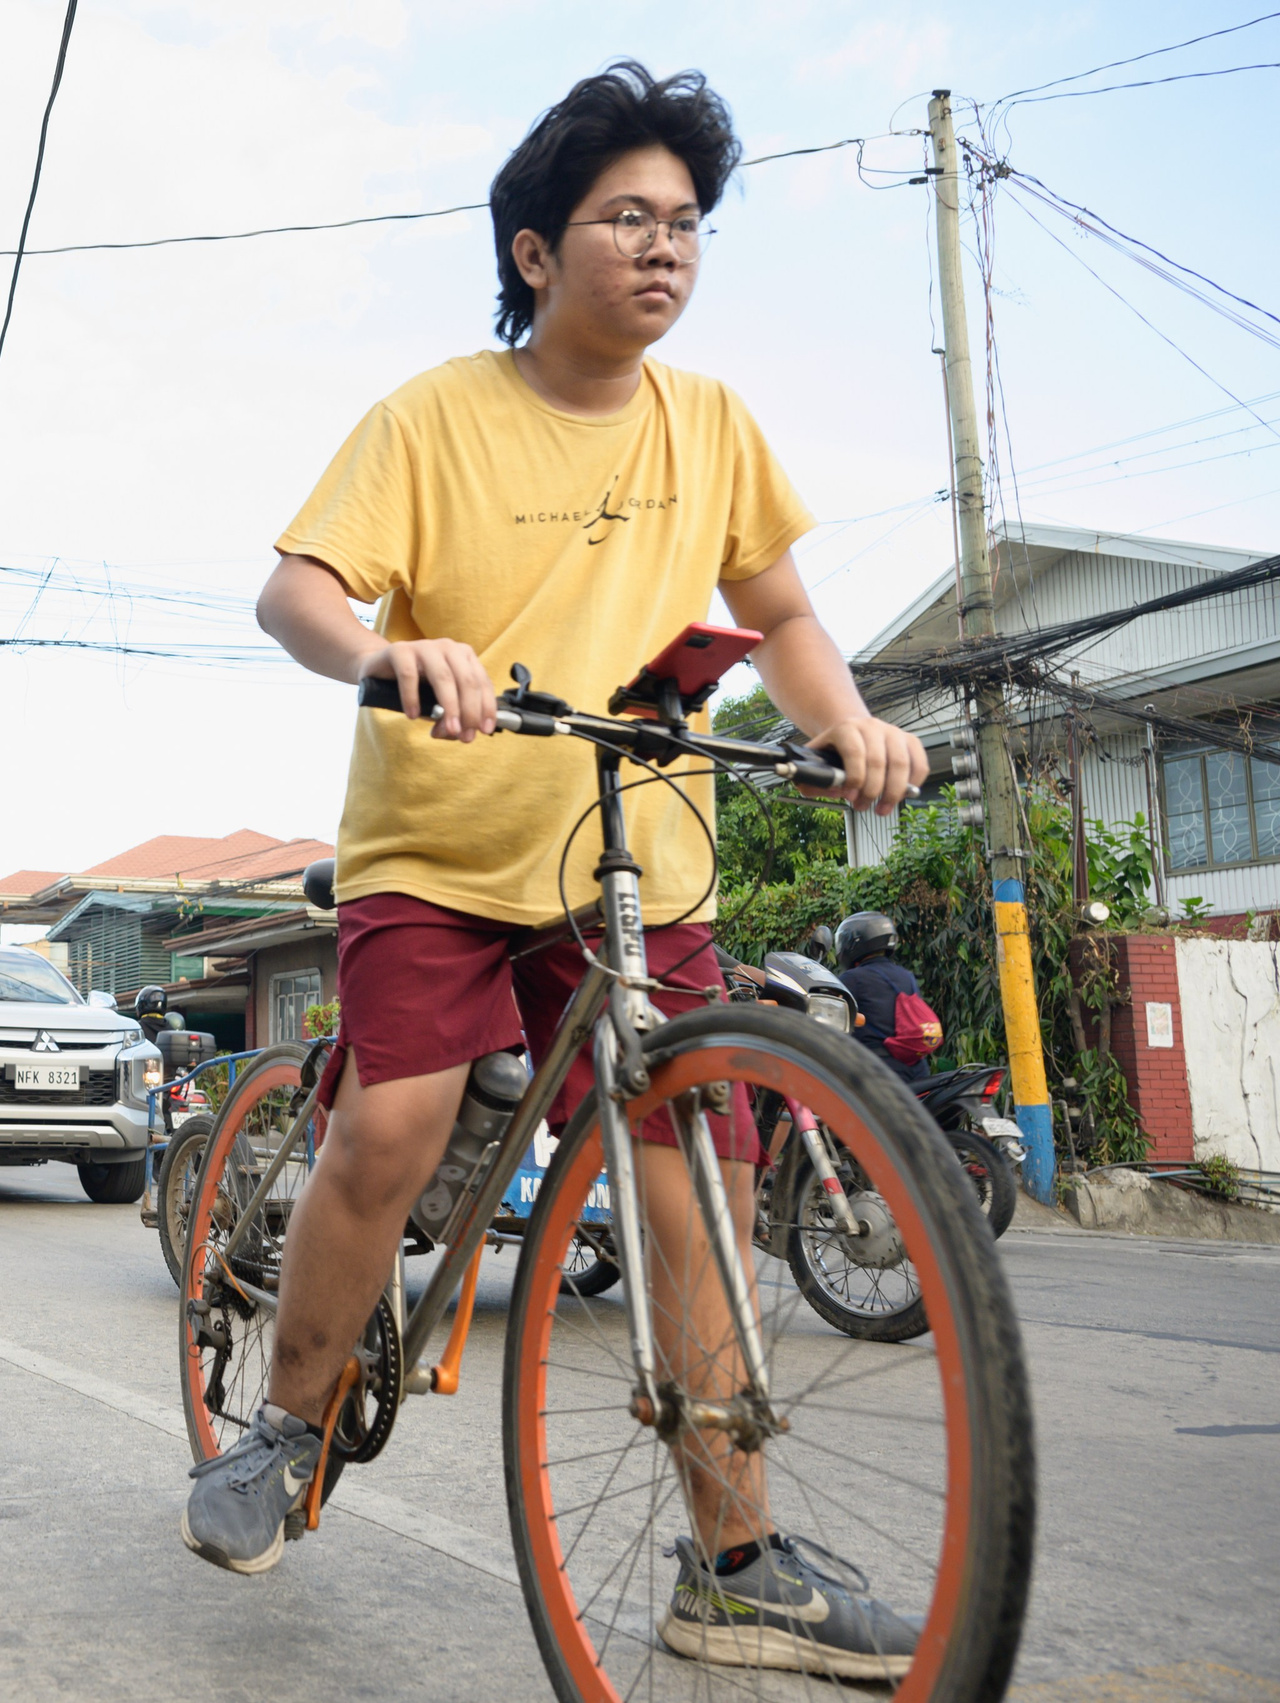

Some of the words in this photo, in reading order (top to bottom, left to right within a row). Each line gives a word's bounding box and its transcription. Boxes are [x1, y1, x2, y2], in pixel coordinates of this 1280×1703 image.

[17, 1070, 40, 1084] NFK
[48, 1071, 78, 1085] 8321
[678, 1590, 718, 1623] NIKE
